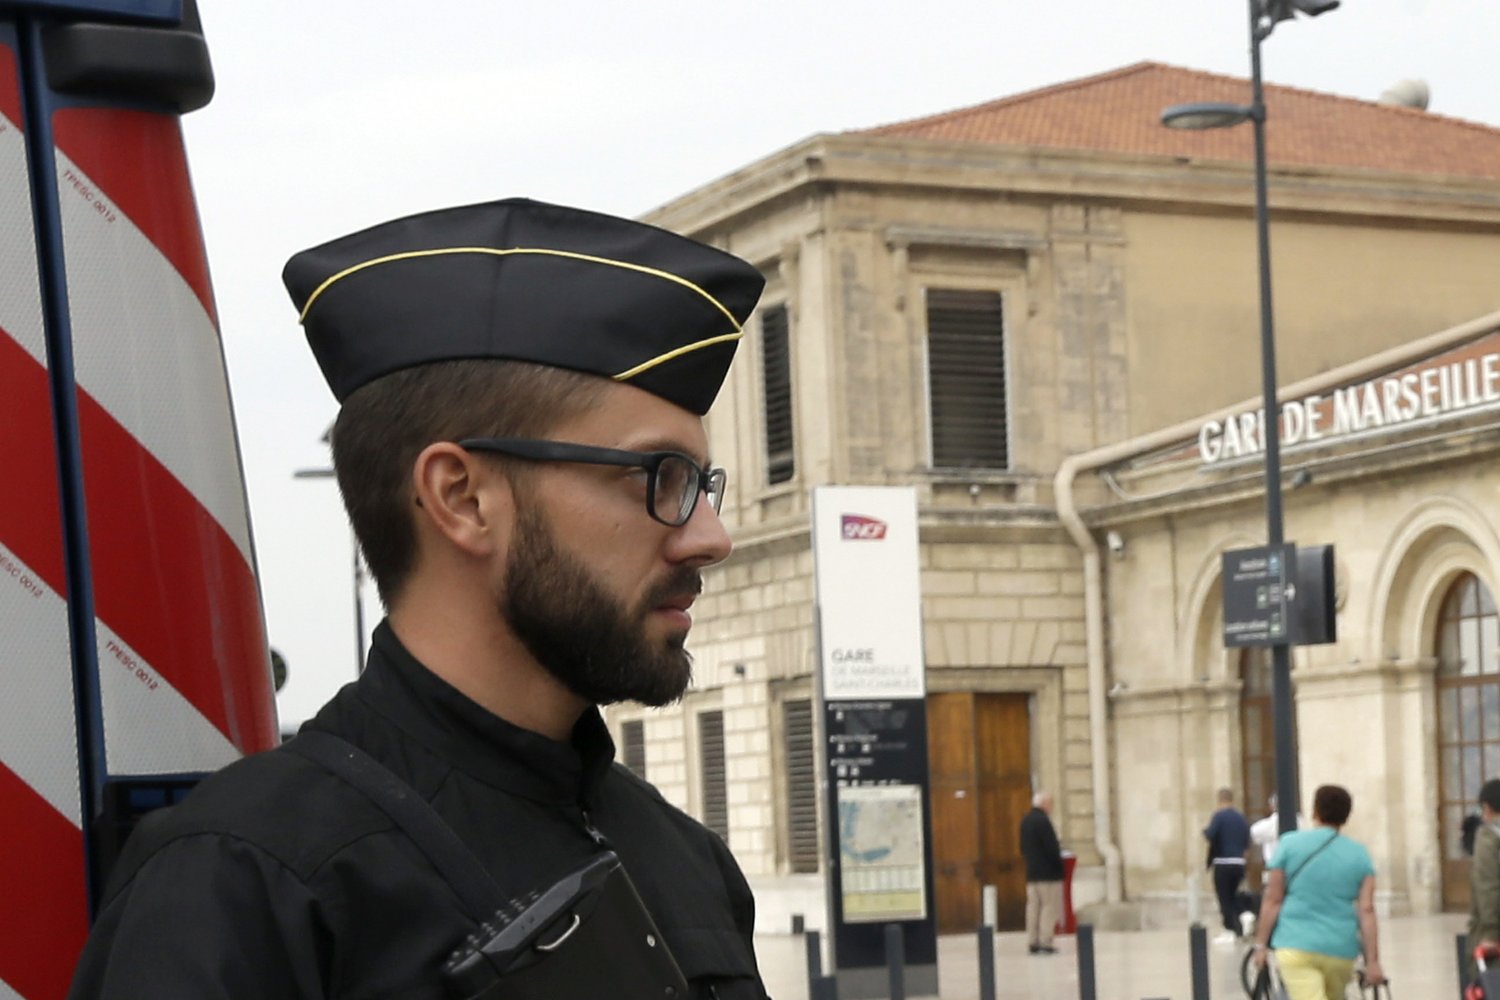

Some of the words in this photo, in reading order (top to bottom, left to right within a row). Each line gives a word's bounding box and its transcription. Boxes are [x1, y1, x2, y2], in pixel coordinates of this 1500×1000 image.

[94, 200, 116, 223] 0012
[1282, 395, 1324, 445] DE
[843, 522, 886, 539] SNCF
[20, 575, 44, 597] 0012
[106, 640, 137, 670] TPESC
[136, 668, 159, 690] 0012
[831, 648, 875, 664] GARE
